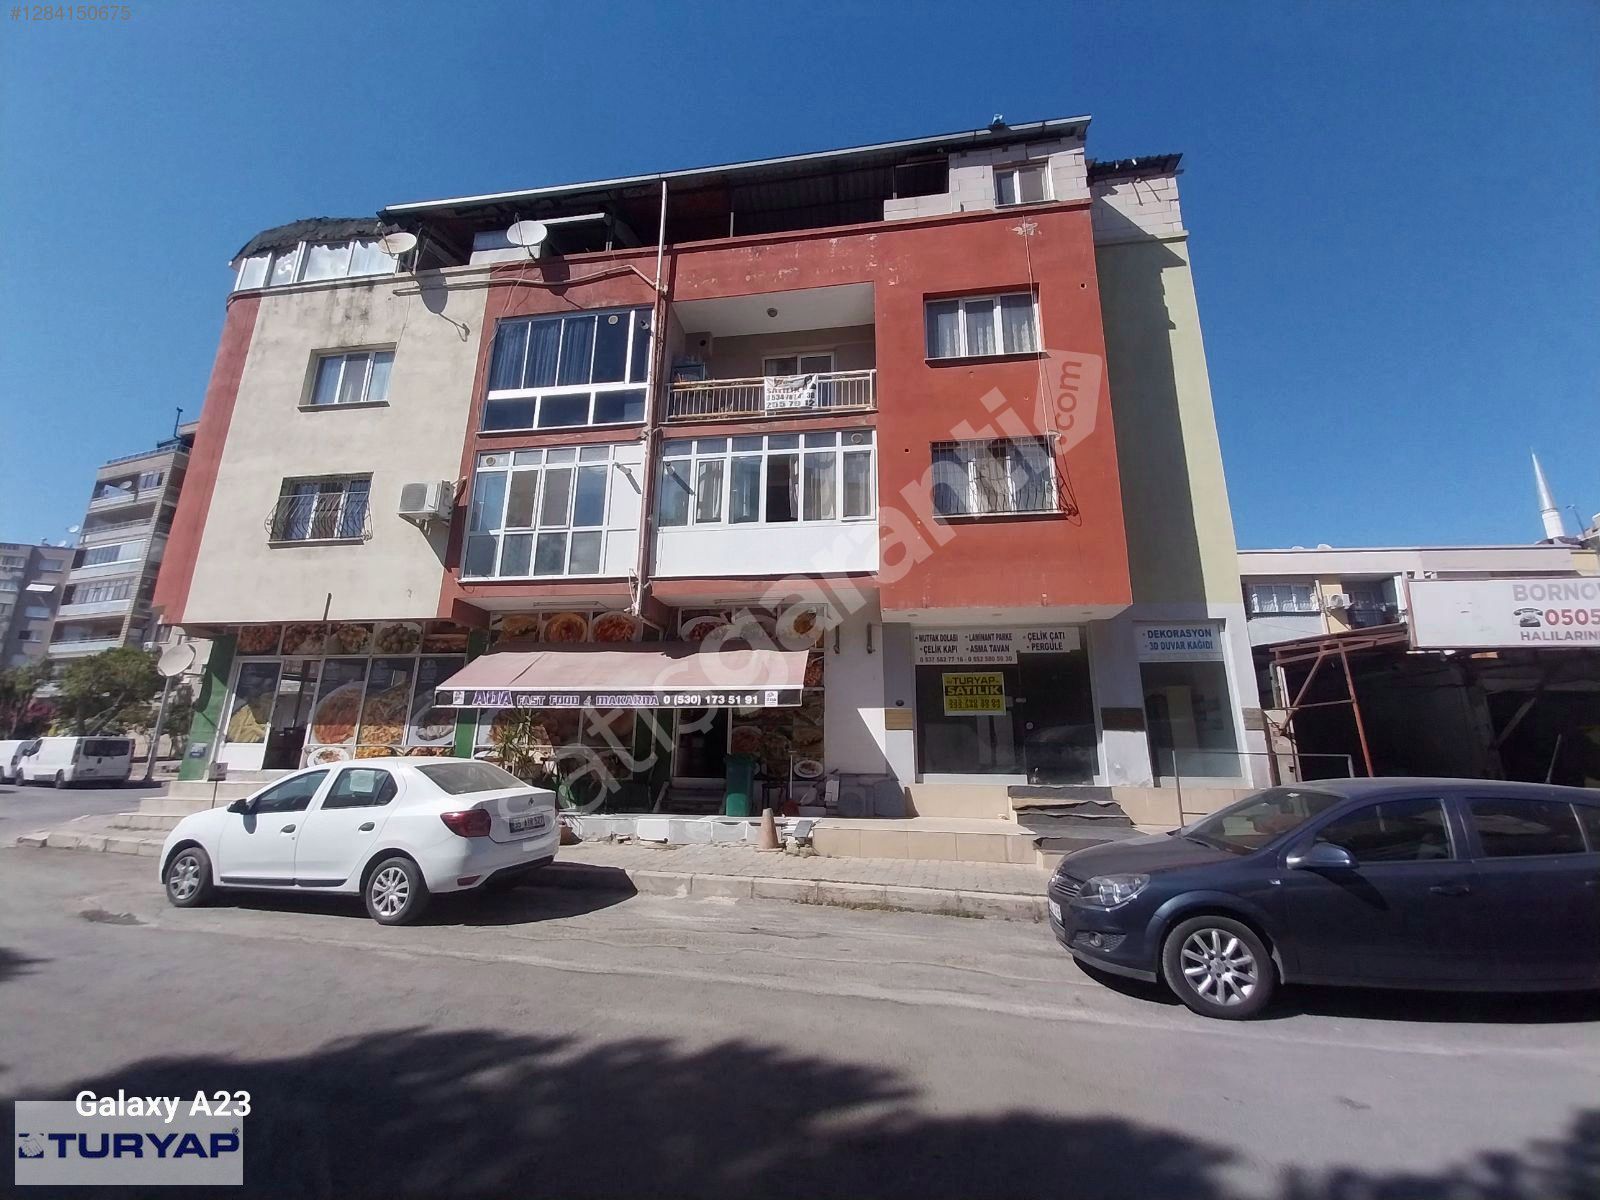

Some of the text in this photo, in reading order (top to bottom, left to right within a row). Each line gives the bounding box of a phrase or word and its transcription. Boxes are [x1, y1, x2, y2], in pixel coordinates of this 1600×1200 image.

[1512, 583, 1600, 601] BORNO
[1545, 609, 1600, 626] 0505
[996, 632, 1012, 641] PARKE
[1027, 630, 1065, 643] ÇELİK ÇATI
[1147, 629, 1212, 639] DEKORASYON
[1521, 631, 1600, 641] HALILARIN
[923, 644, 958, 655] ÇELİK KAPI
[970, 645, 1010, 653] ASMA TAVAN
[1149, 642, 1159, 650] 3D
[1160, 641, 1186, 650] DUVAR
[952, 676, 996, 685] TURYAP
[947, 686, 1000, 696] SATILIK
[516, 694, 546, 706] FAST
[549, 695, 580, 706] FOOD
[595, 695, 660, 706] MAKARNA
[663, 695, 671, 705] 0
[673, 694, 702, 706] (530)
[705, 694, 726, 705] 173
[728, 694, 741, 705] 51
[744, 694, 758, 705] 91
